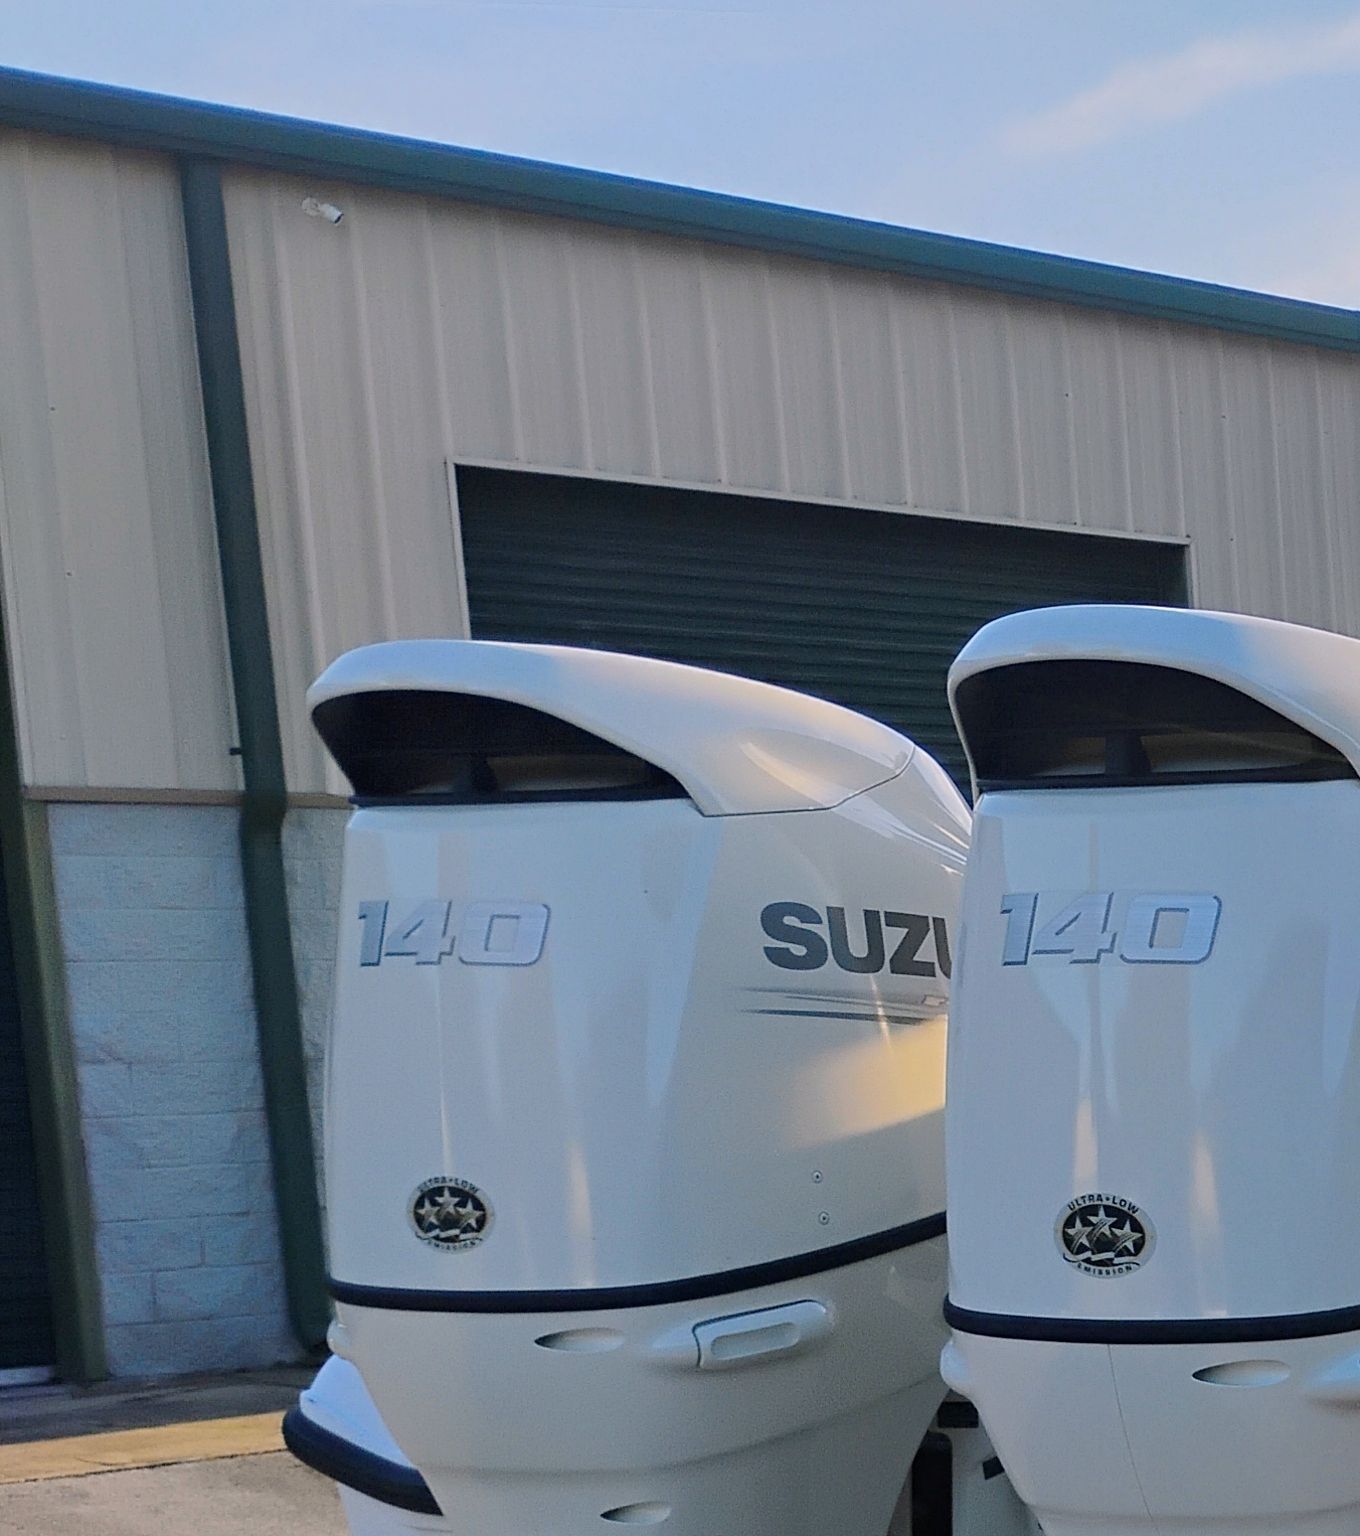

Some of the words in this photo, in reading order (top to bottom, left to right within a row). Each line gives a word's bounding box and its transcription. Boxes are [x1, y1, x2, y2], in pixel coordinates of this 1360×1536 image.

[358, 898, 552, 967] 140
[1000, 890, 1223, 967] 140
[1111, 1195, 1140, 1215] LOW
[1077, 1262, 1133, 1276] EMISSION
